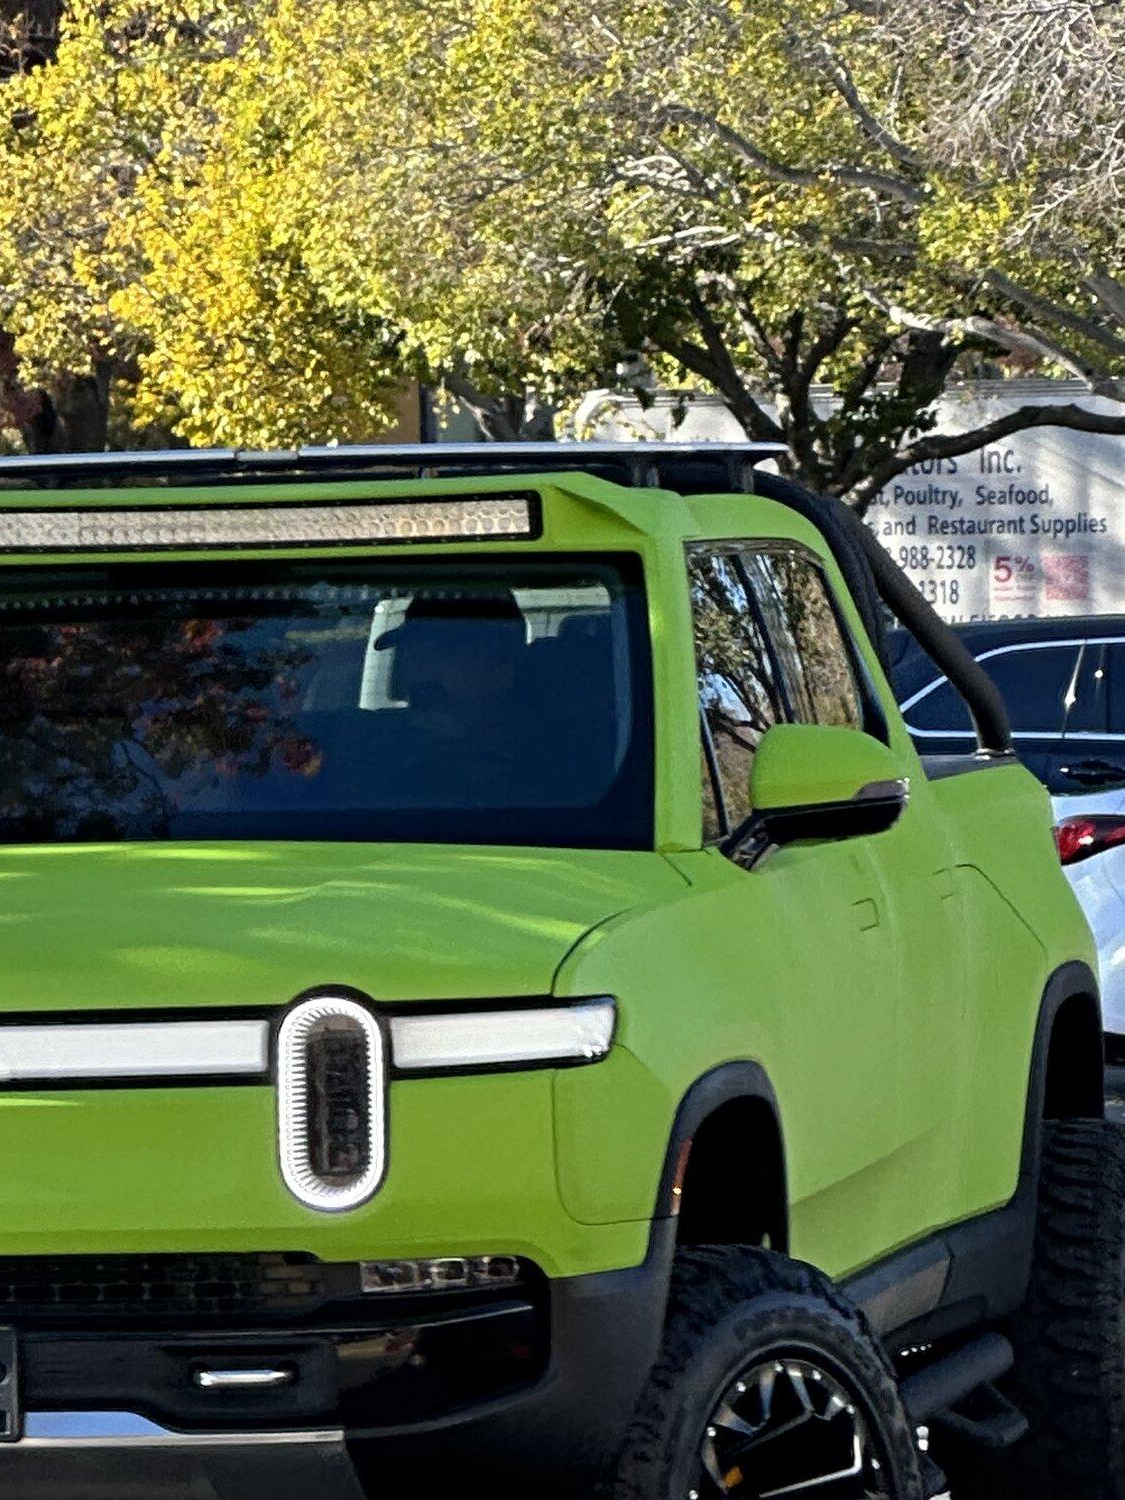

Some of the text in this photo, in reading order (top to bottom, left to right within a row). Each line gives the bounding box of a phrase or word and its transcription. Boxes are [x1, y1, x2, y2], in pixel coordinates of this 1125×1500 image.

[980, 449, 1022, 474] Inc.
[893, 484, 963, 510] Poultry,
[975, 484, 1053, 506] Seafood,
[883, 515, 916, 536] and
[928, 514, 1025, 536] Restaurant
[1030, 512, 1107, 538] Supplies
